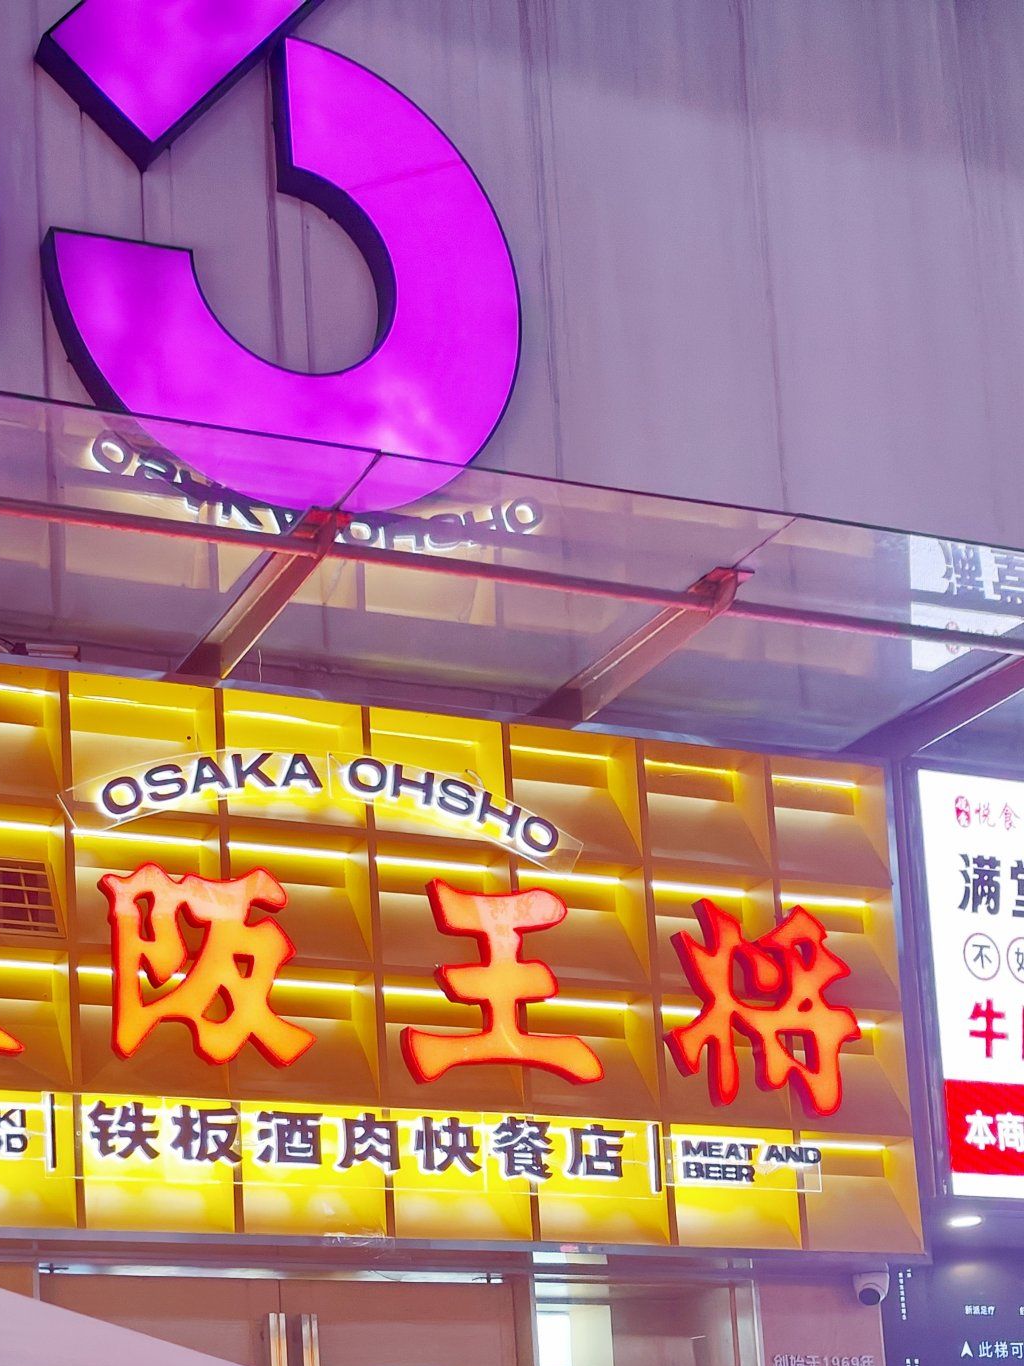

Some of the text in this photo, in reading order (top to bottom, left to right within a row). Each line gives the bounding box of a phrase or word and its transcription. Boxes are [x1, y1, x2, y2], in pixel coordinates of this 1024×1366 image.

[101, 752, 559, 853] OSAKA OHSHO
[87, 1100, 625, 1179] 铁板酒肉快餐店
[681, 1140, 822, 1164] MEAT AND
[683, 1161, 756, 1183] BEER
